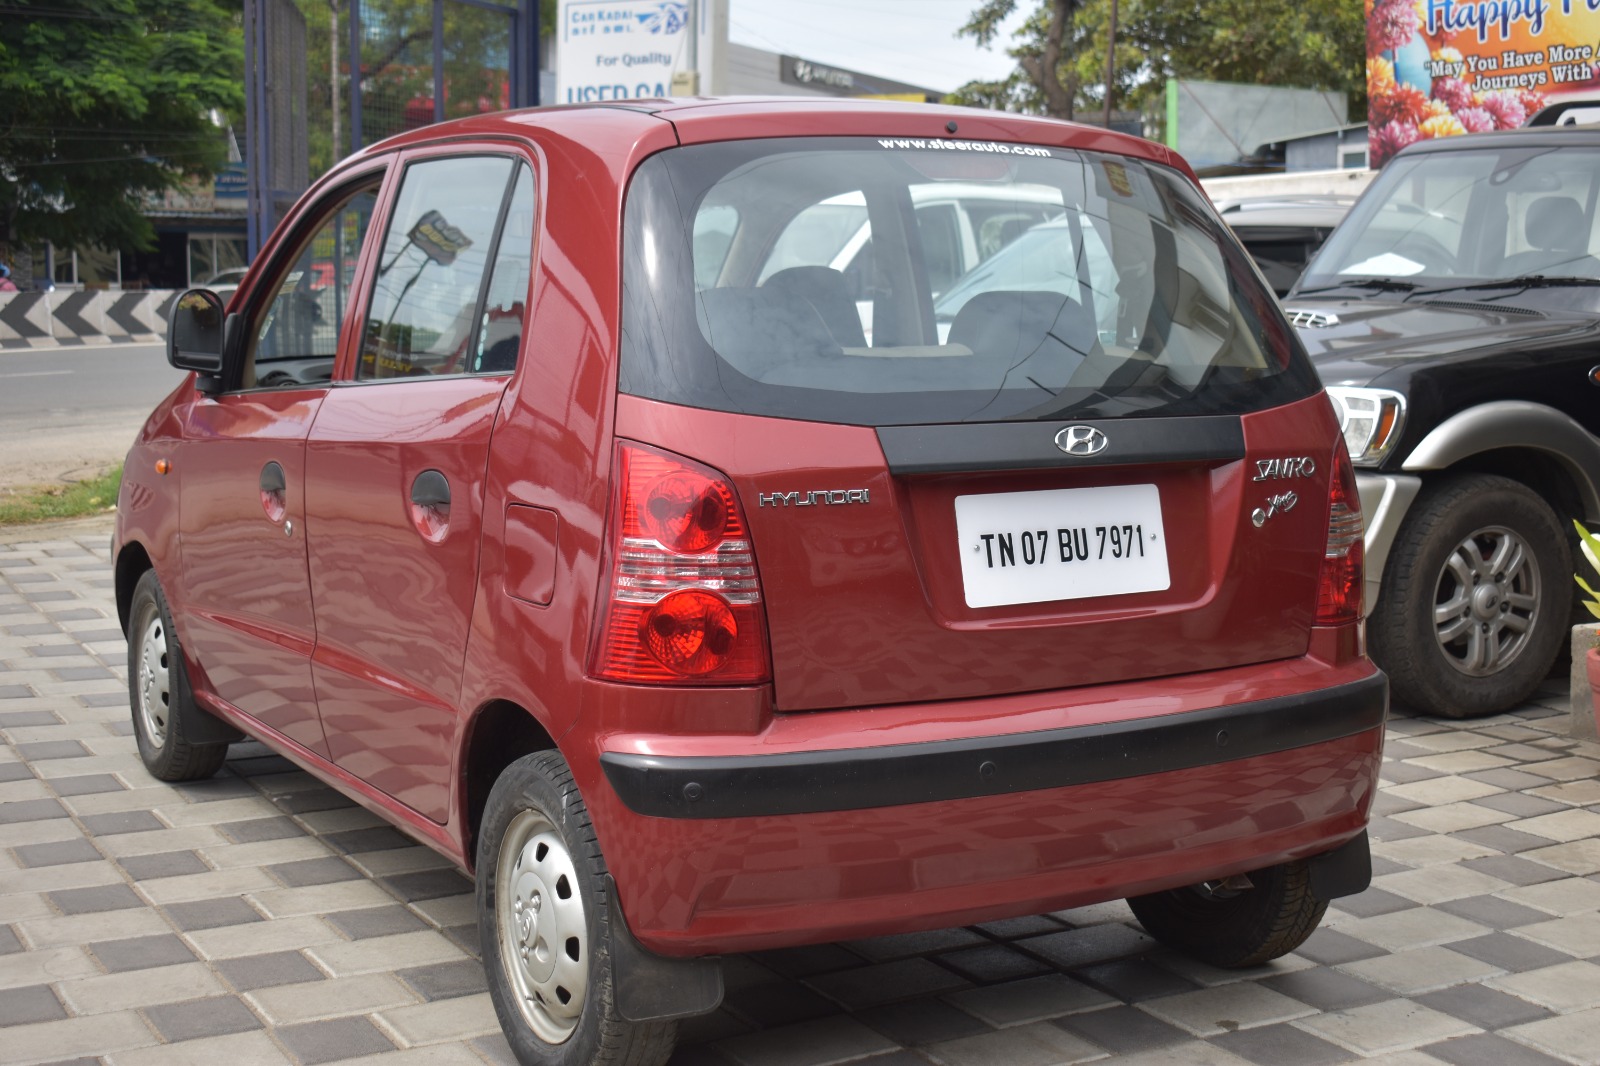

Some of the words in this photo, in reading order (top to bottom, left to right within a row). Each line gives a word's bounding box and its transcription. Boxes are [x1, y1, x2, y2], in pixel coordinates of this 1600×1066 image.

[1427, 0, 1549, 42] Happy
[596, 54, 618, 67] For
[622, 51, 672, 68] Quality
[1466, 55, 1499, 73] You
[1502, 51, 1543, 70] Have
[1548, 44, 1592, 64] More
[1471, 71, 1547, 92] Journeys
[1551, 61, 1592, 83] With
[878, 138, 1051, 158] www.steerauto.com
[1253, 456, 1315, 481] SANTRO
[759, 488, 869, 507] HYUNDAI
[980, 533, 1016, 568] TN
[1021, 530, 1048, 565] 07
[1057, 527, 1089, 562] BU
[1095, 524, 1144, 560] 7971
